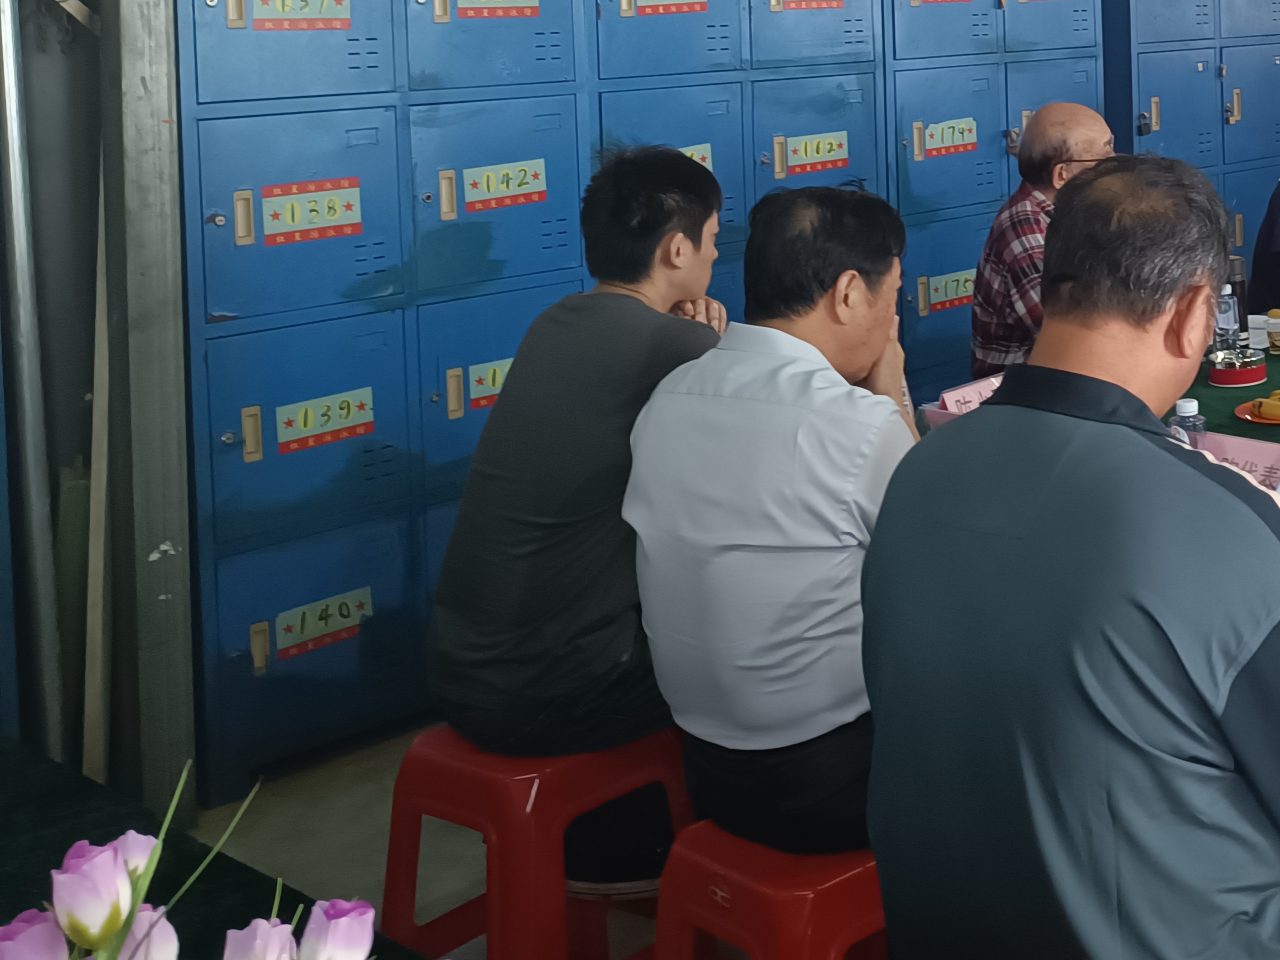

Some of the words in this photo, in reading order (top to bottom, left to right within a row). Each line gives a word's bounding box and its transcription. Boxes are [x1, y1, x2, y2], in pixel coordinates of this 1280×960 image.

[804, 140, 836, 158] 162
[484, 167, 530, 193] 142
[288, 198, 338, 224] 138
[944, 276, 973, 298] 175
[302, 399, 351, 429] 139
[300, 601, 351, 635] 140
